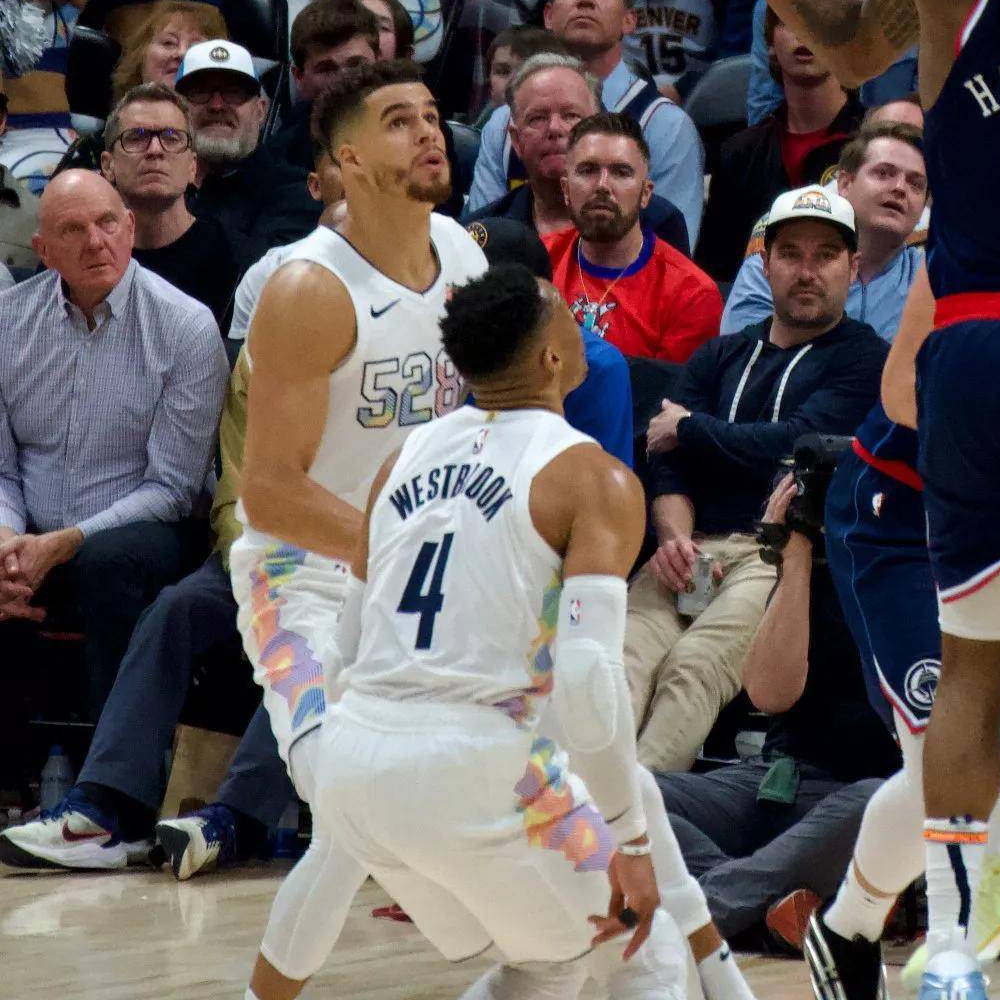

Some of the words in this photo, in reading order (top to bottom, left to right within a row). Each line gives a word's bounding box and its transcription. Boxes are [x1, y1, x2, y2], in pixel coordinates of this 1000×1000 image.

[634, 7, 700, 37] ENVER
[638, 34, 687, 76] 15
[357, 349, 464, 429] 528
[388, 462, 514, 523] WESTBROOK
[396, 532, 455, 650] 4
